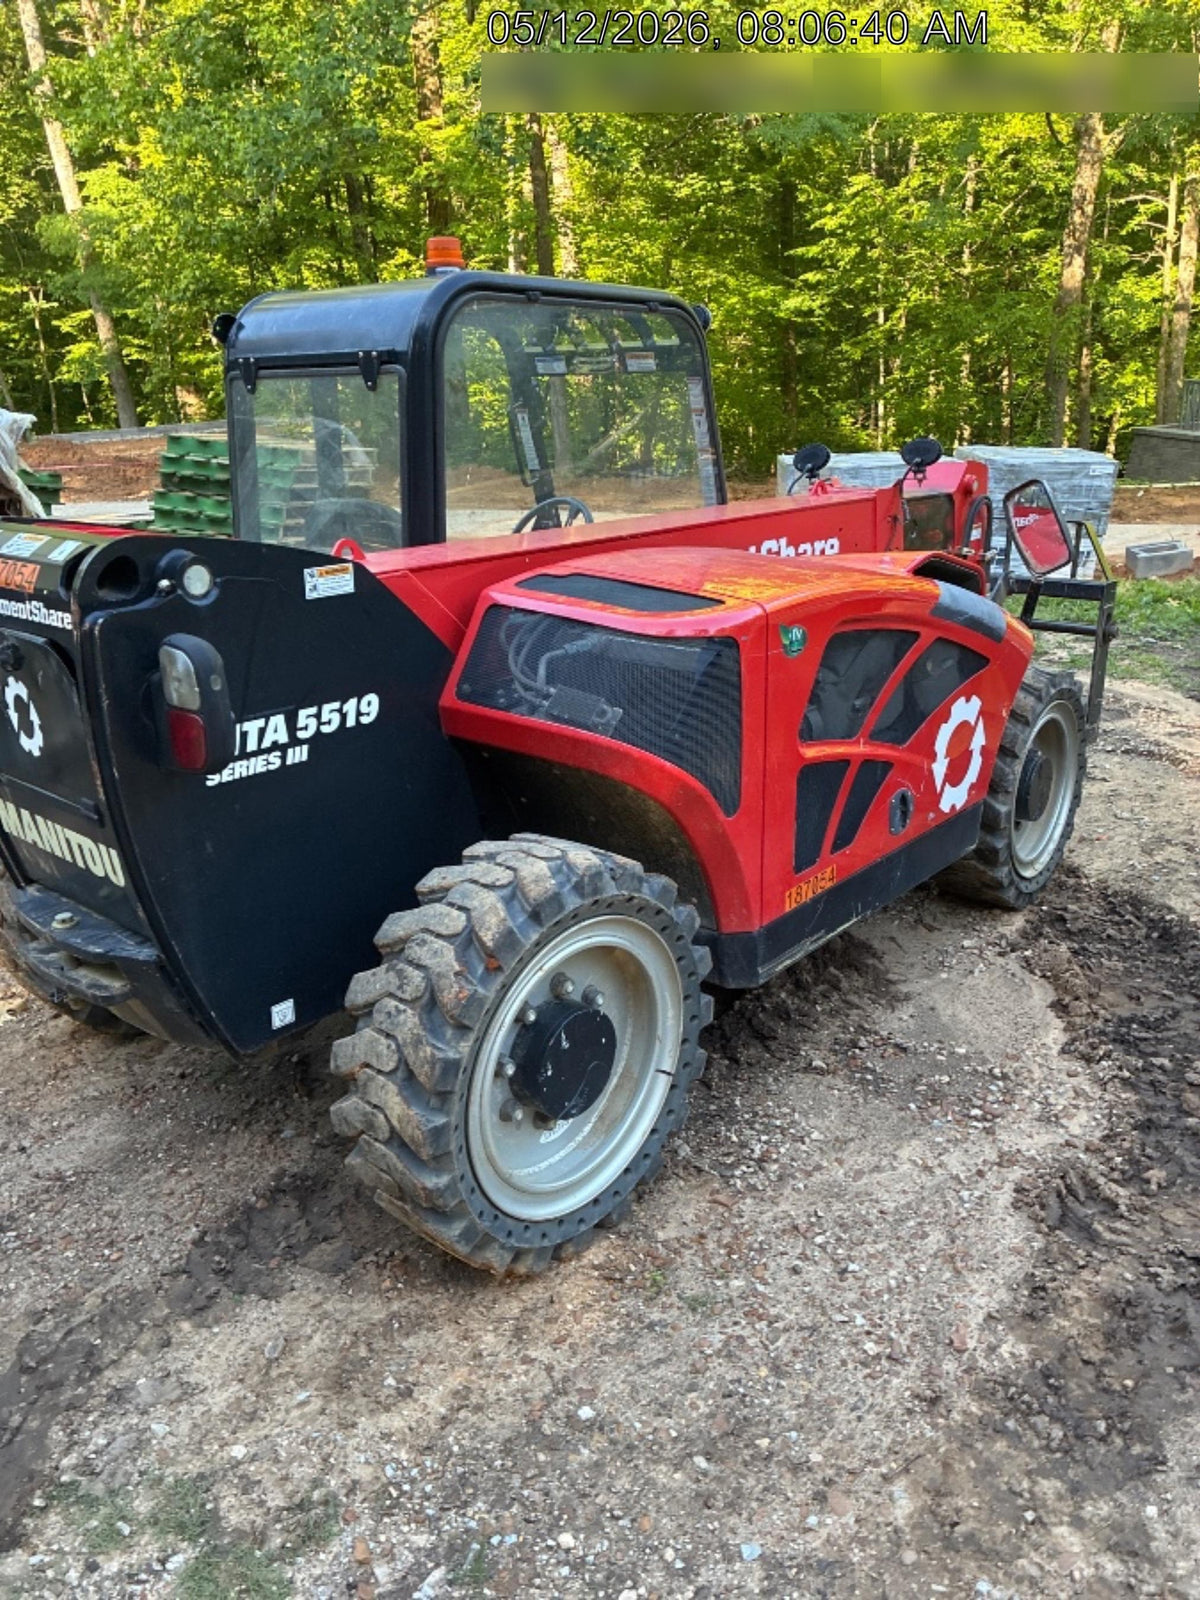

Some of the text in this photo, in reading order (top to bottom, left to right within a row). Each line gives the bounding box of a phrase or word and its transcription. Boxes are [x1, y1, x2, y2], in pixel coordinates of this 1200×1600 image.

[233, 692, 380, 756] TA 5519
[205, 751, 282, 787] SERIES
[0, 797, 125, 888] MANITOU
[787, 866, 835, 909] 187054
